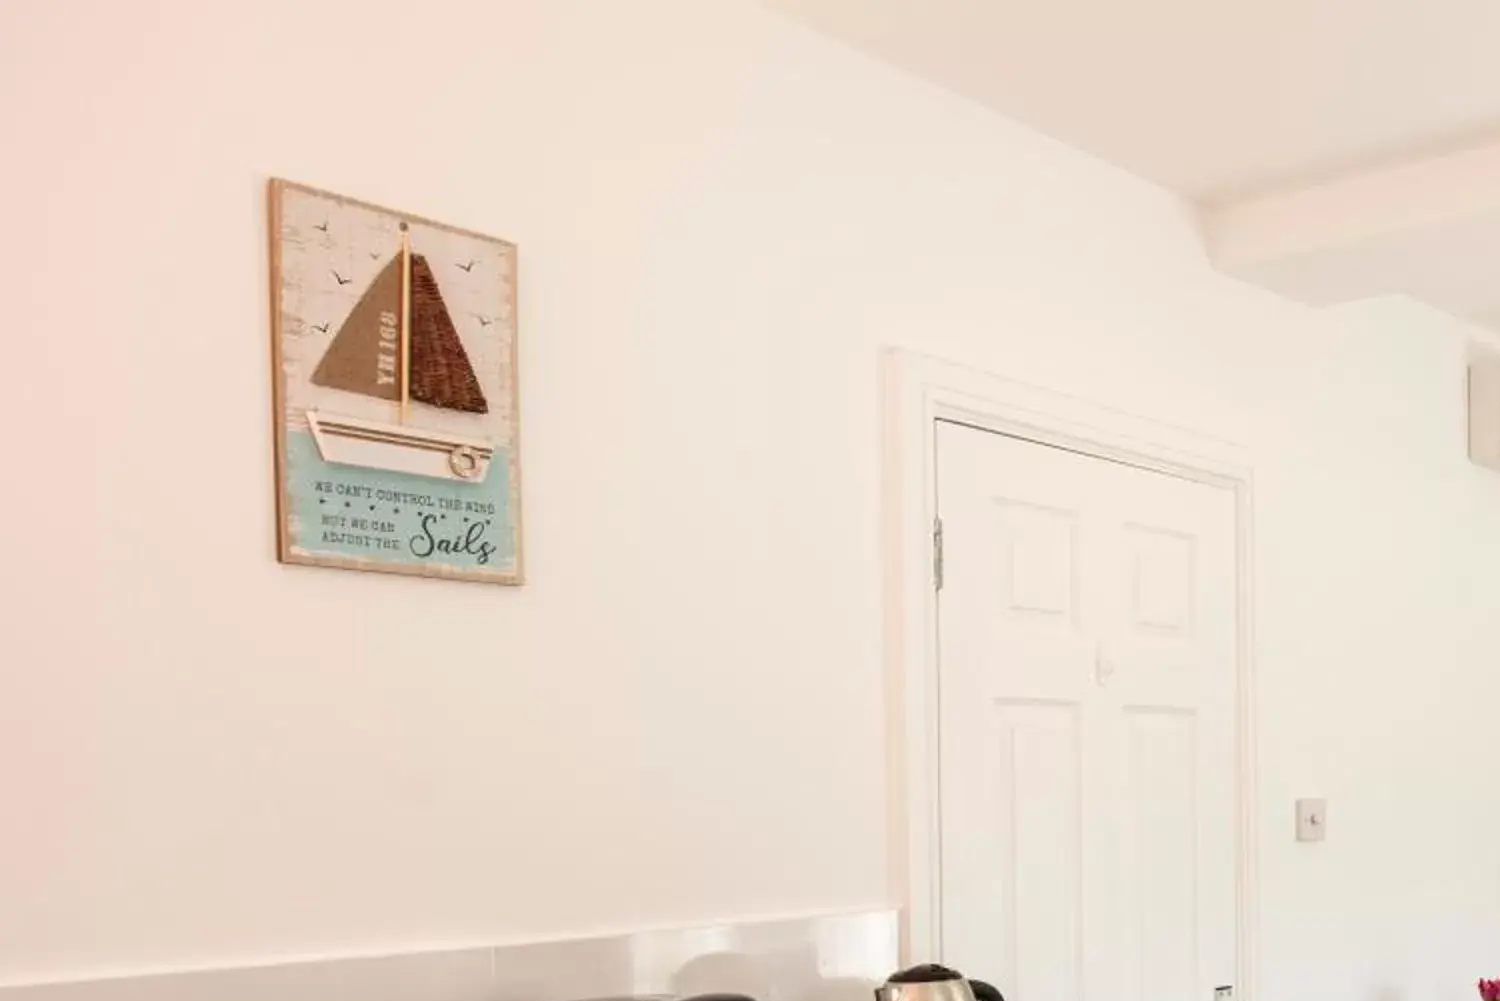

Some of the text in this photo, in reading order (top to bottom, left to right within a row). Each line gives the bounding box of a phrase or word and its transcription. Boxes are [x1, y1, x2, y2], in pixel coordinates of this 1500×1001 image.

[375, 489, 435, 507] CONTROL
[438, 497, 463, 511] THE
[371, 520, 396, 533] CAN
[321, 531, 401, 551] ADJUST THE
[409, 512, 497, 565] Sails
